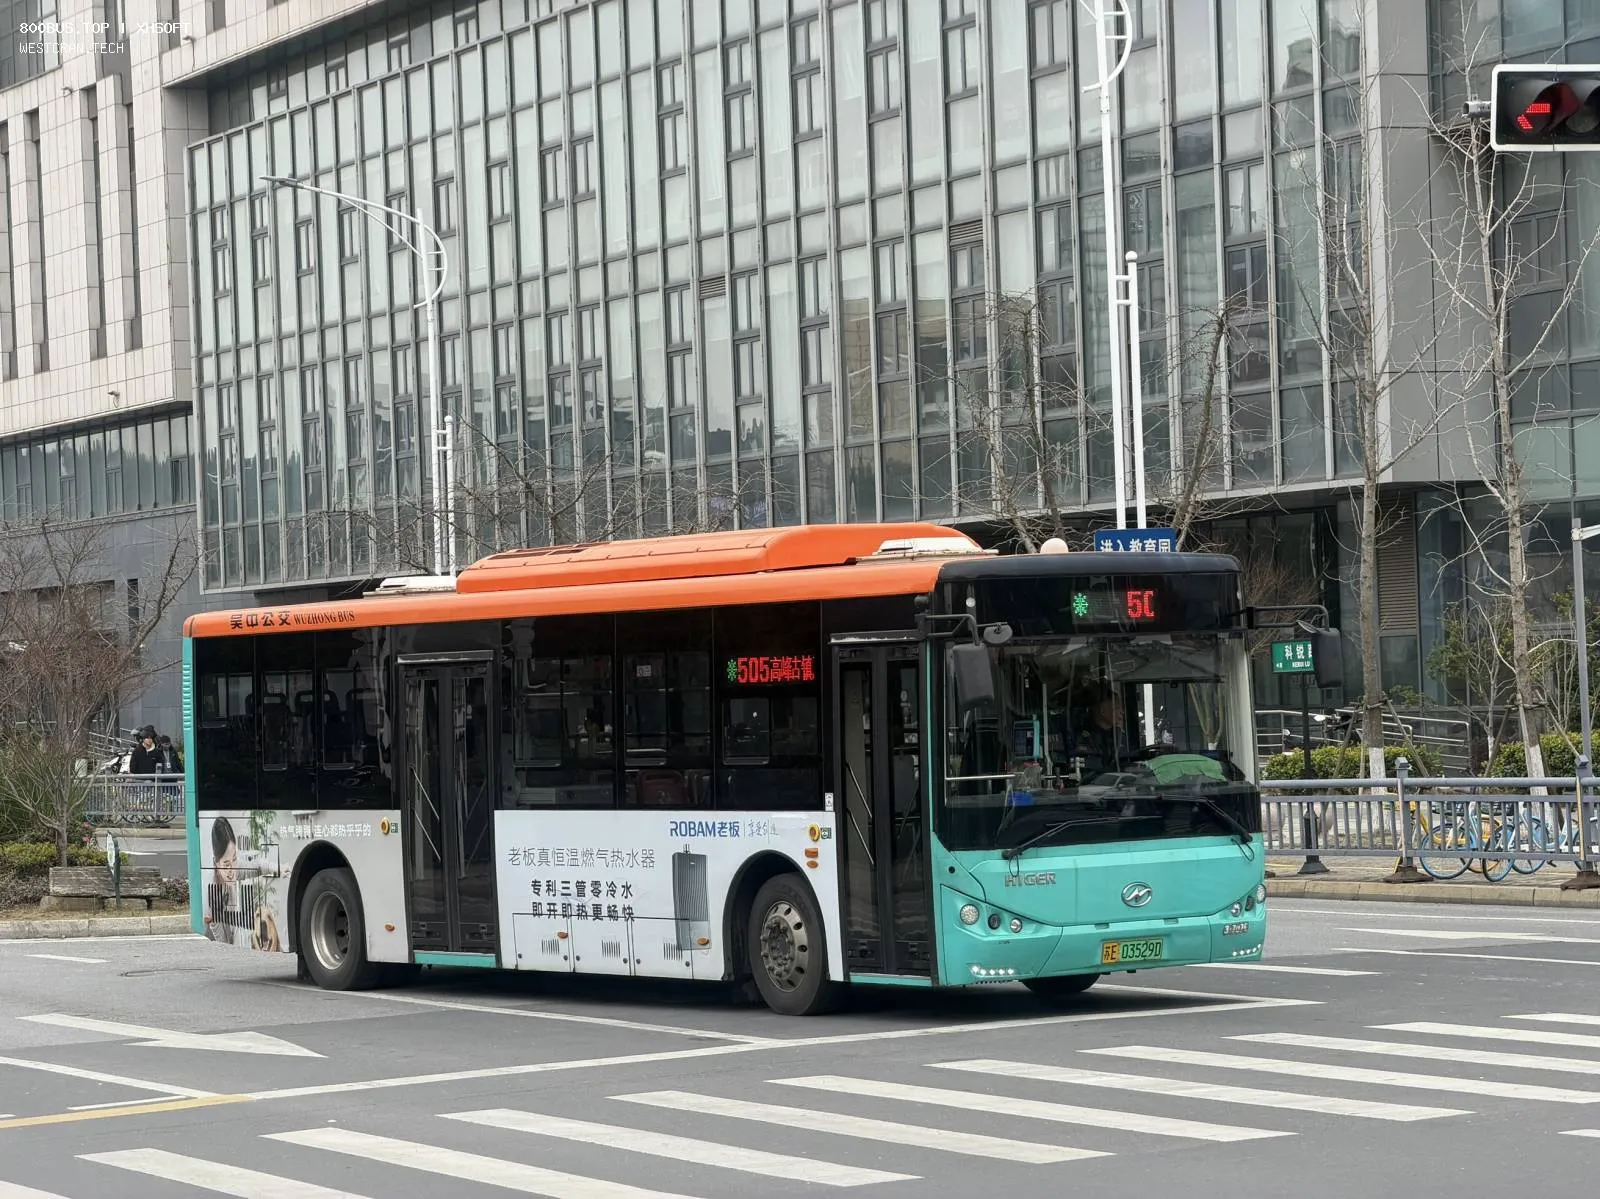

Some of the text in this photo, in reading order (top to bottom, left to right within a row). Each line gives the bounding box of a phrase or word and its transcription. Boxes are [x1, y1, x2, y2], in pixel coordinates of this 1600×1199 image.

[230, 610, 355, 629] 吴中公交 WUZHONG BUS
[508, 846, 656, 869] 老板真恒温燃气热水器
[530, 878, 634, 899] 专利三管零冷水
[1005, 871, 1057, 888] HIGER
[532, 901, 635, 922] 即开即热更畅快
